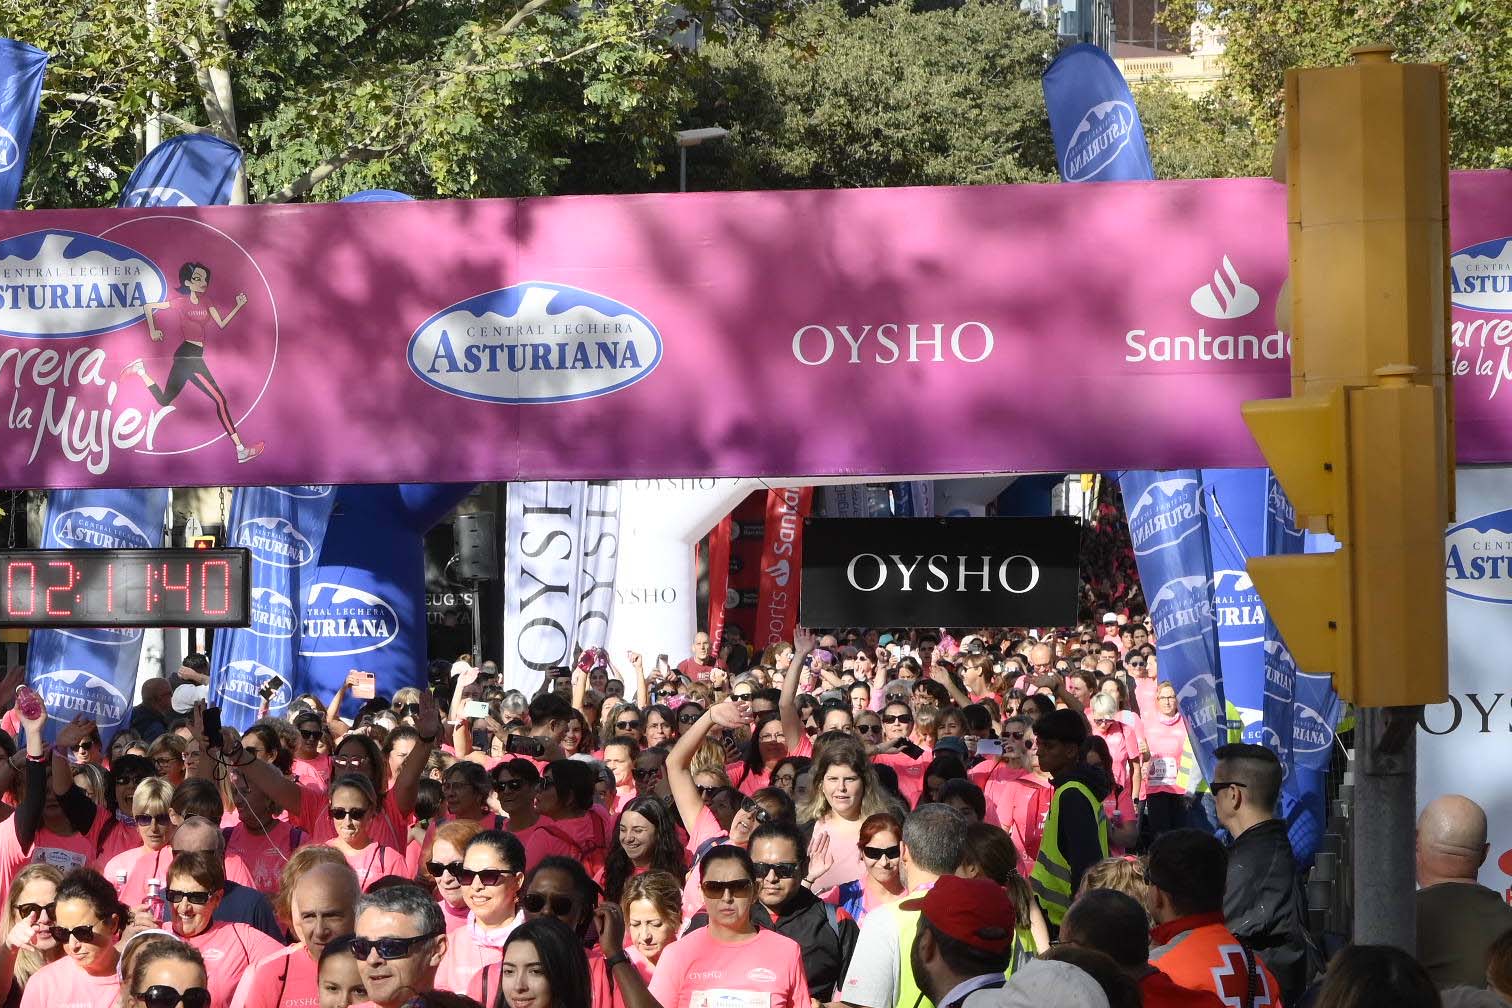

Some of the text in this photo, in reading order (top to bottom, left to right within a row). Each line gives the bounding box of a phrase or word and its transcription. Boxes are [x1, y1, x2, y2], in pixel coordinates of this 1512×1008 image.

[70, 265, 141, 278] LECHERA
[466, 323, 634, 337] CENTRAL LECHERA
[791, 321, 995, 365] OYSHO
[1451, 318, 1512, 348] arre
[426, 329, 642, 374] ASTURIANA
[1475, 349, 1493, 376] la
[8, 388, 32, 429] la
[27, 381, 176, 475] Mujer
[1473, 541, 1512, 551] CENT
[846, 552, 1040, 594] OYSHO
[7, 560, 230, 616] 02:11:40
[1216, 605, 1265, 626] URIA
[1292, 726, 1326, 745] RIANA
